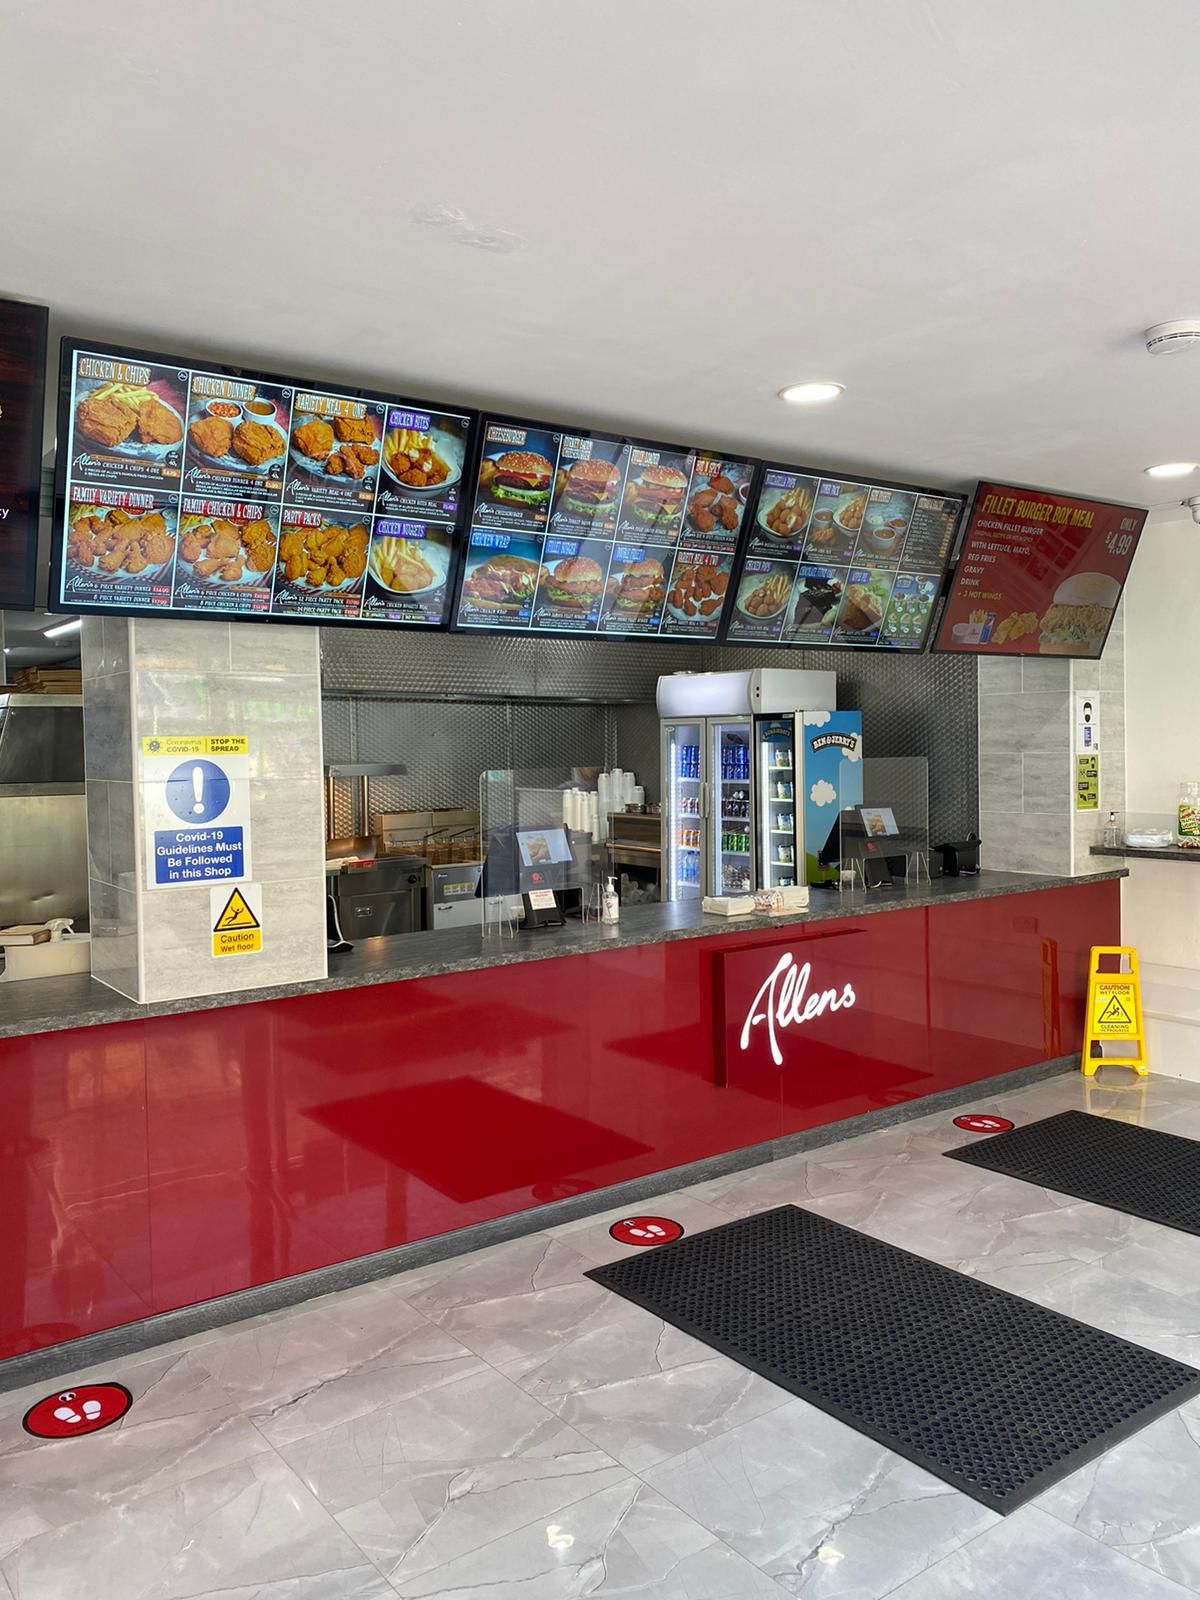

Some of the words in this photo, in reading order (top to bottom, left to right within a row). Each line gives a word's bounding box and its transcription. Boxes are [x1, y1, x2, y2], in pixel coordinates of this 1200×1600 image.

[80, 358, 115, 379] CHICKEN
[118, 364, 122, 380] &
[125, 365, 151, 385] CHIPS
[193, 376, 225, 396] CHICKEN
[227, 381, 256, 400] DINNER
[296, 393, 323, 412] VARIETY
[325, 398, 342, 415] MEAL
[352, 402, 367, 419] ONE
[390, 411, 413, 427] CHICKEN
[415, 414, 430, 430] BITES
[102, 462, 124, 470] CHICKEN
[73, 487, 96, 502] FAMILY
[100, 489, 126, 506] VARIETY
[129, 492, 154, 508] DINNER
[183, 498, 205, 514] FAMILY
[207, 500, 235, 516] CHICKEN
[243, 504, 263, 520] CHIPS
[982, 494, 1016, 516] FILLET
[1014, 500, 1052, 522] BURGER
[1054, 506, 1072, 525] BOX
[1072, 509, 1094, 528] MEAL
[284, 510, 302, 524] PARTY
[303, 512, 321, 526] PACKS
[1120, 517, 1138, 531] ONLY
[378, 521, 400, 535] CHICKEN
[402, 523, 425, 538] NUGGETS
[977, 520, 1002, 531] CHICKEN
[1003, 523, 1021, 533] FILLET
[1021, 526, 1044, 536] BURGER
[971, 540, 986, 549] WITH
[968, 553, 980, 561] REG
[980, 554, 996, 563] FRIES
[964, 565, 984, 574] GRAVY
[960, 577, 980, 587] DRINK
[969, 590, 981, 599] HOT
[982, 591, 1002, 600] WINGS
[813, 738, 827, 749] BEN
[831, 736, 856, 748] JERRY'S
[176, 831, 224, 842] Covid-19
[157, 845, 213, 856] Guidelines
[216, 842, 242, 852] Must
[168, 858, 182, 867] Be
[185, 854, 233, 866] Followed
[170, 870, 179, 879] in
[182, 868, 201, 878] this
[204, 867, 231, 877] Shop
[220, 932, 254, 943] Caution
[221, 945, 235, 953] Wet
[237, 943, 254, 951] floor
